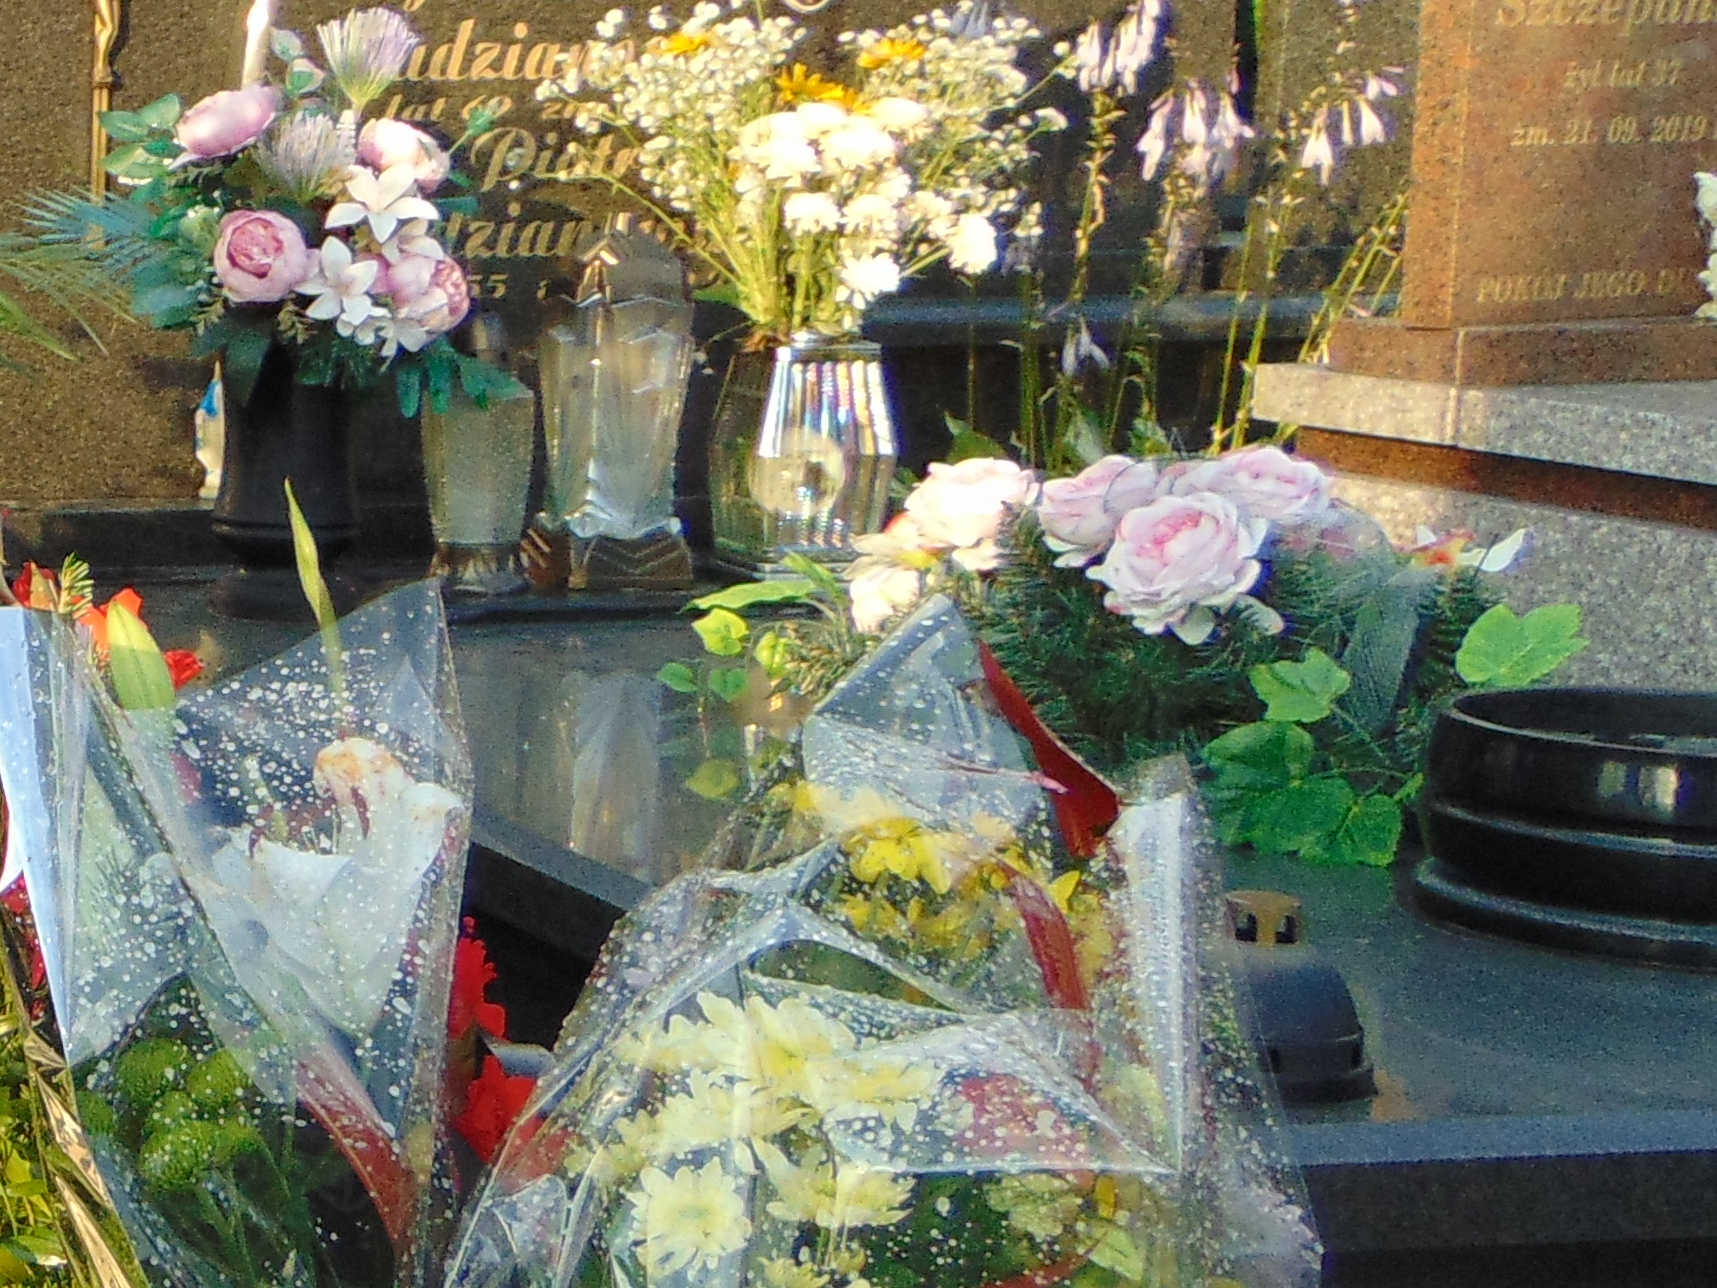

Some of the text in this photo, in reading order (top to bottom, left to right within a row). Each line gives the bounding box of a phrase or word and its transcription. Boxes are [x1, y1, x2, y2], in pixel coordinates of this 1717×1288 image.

[1609, 60, 1647, 88] lat
[1509, 124, 1556, 147] zm.
[1649, 113, 1709, 144] 2019
